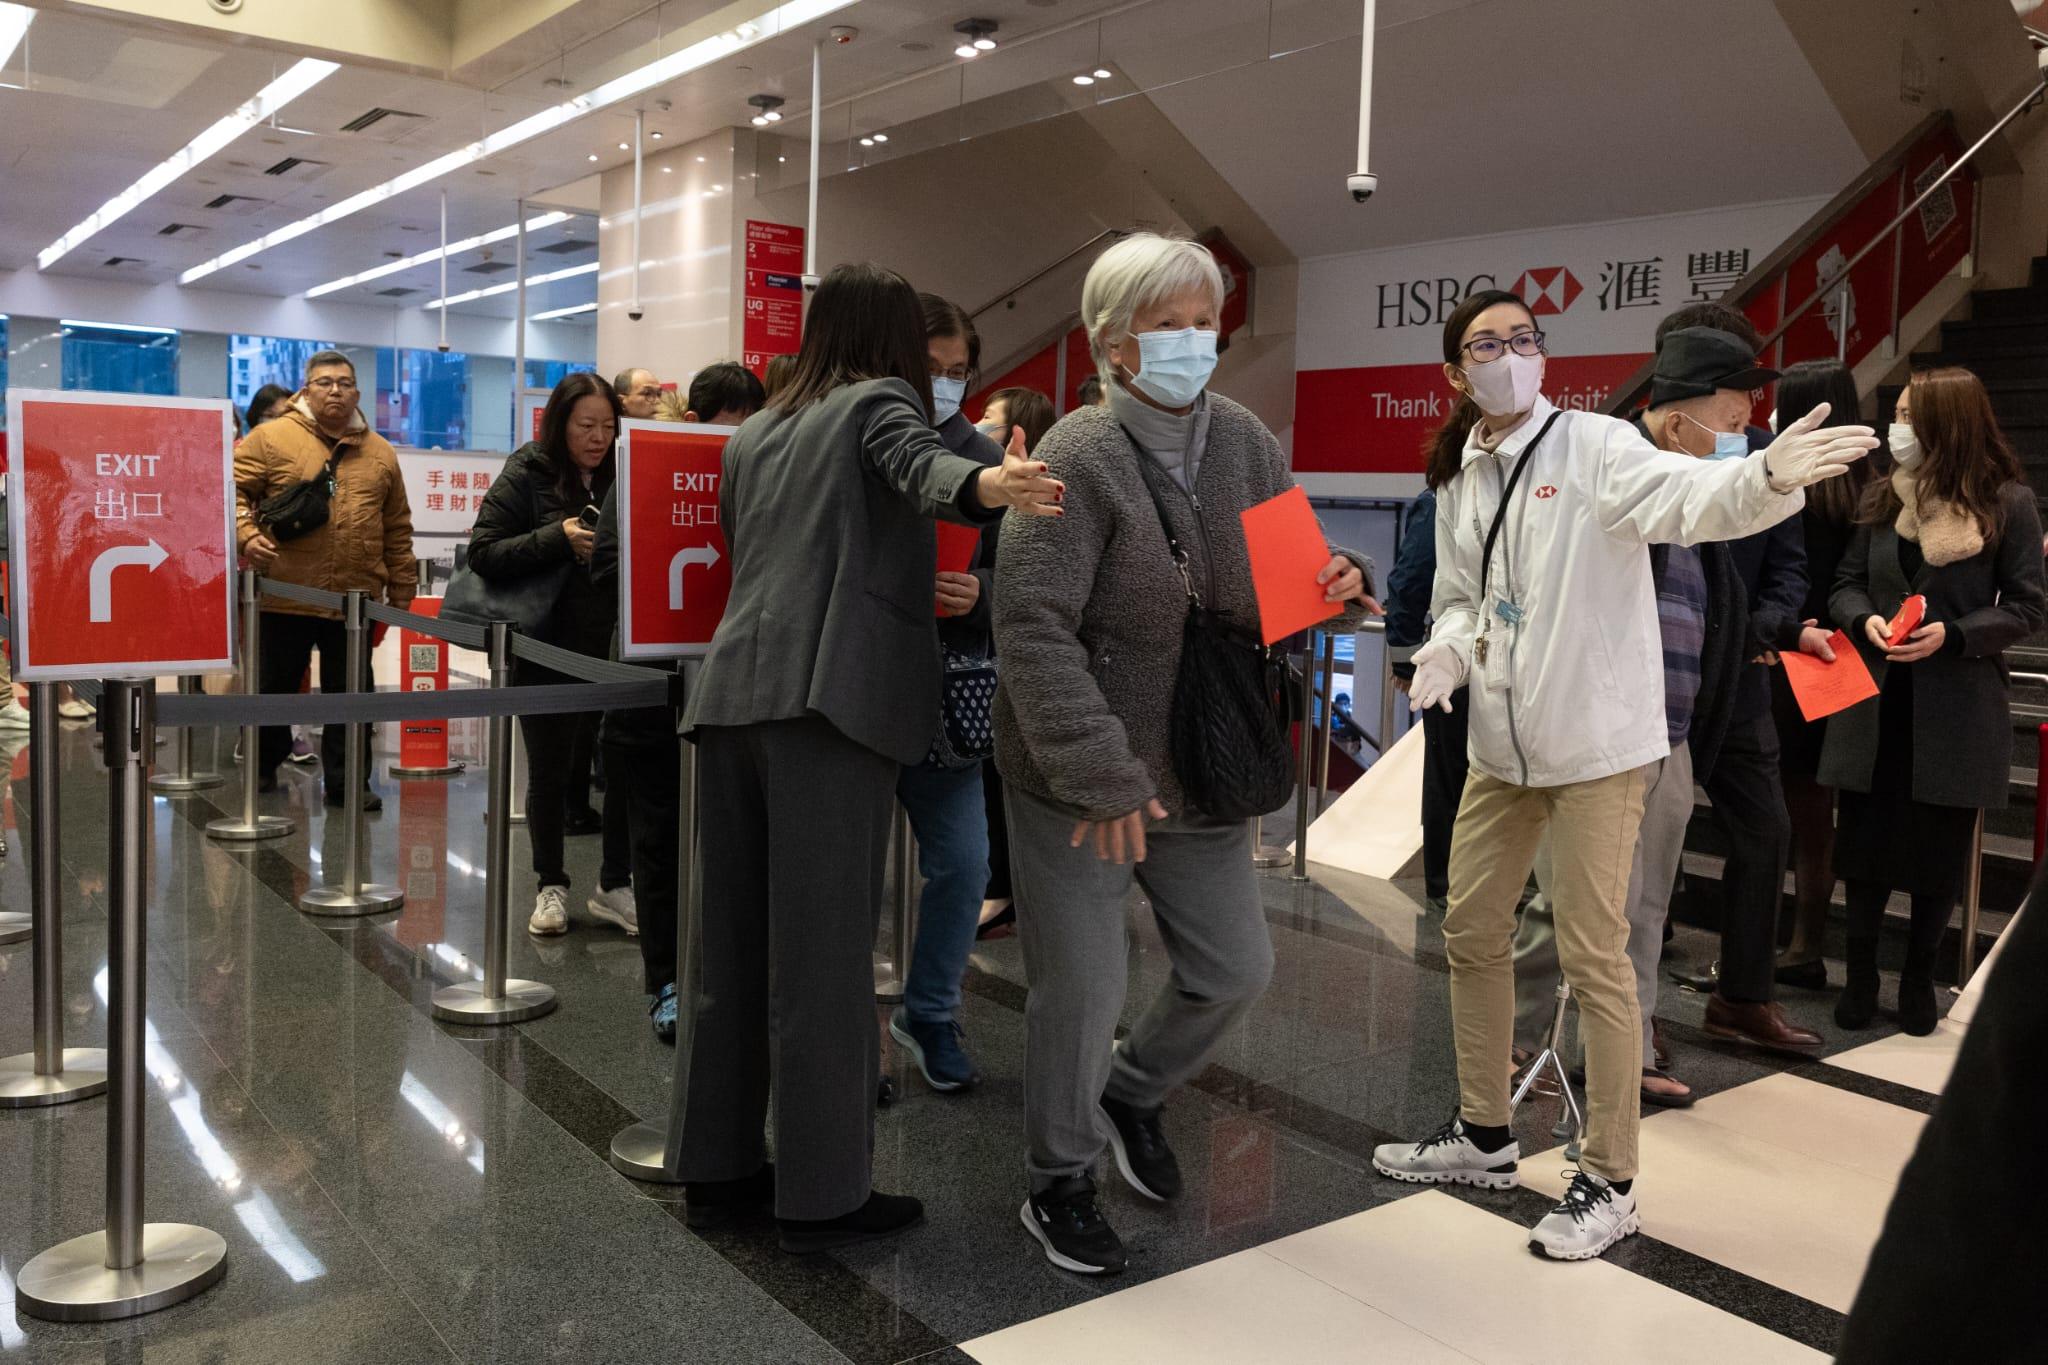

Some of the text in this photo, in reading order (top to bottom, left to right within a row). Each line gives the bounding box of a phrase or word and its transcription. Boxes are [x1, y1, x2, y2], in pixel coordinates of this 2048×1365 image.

[748, 243, 756, 253] 2
[747, 271, 754, 281] 1
[747, 299, 764, 311] UG
[746, 354, 760, 365] LG
[1371, 391, 1441, 418] Thank
[95, 453, 161, 477] EXIT
[427, 470, 491, 490] 手機隨
[673, 472, 718, 492] EXIT
[95, 489, 162, 520] 出口
[672, 501, 718, 527] 出口
